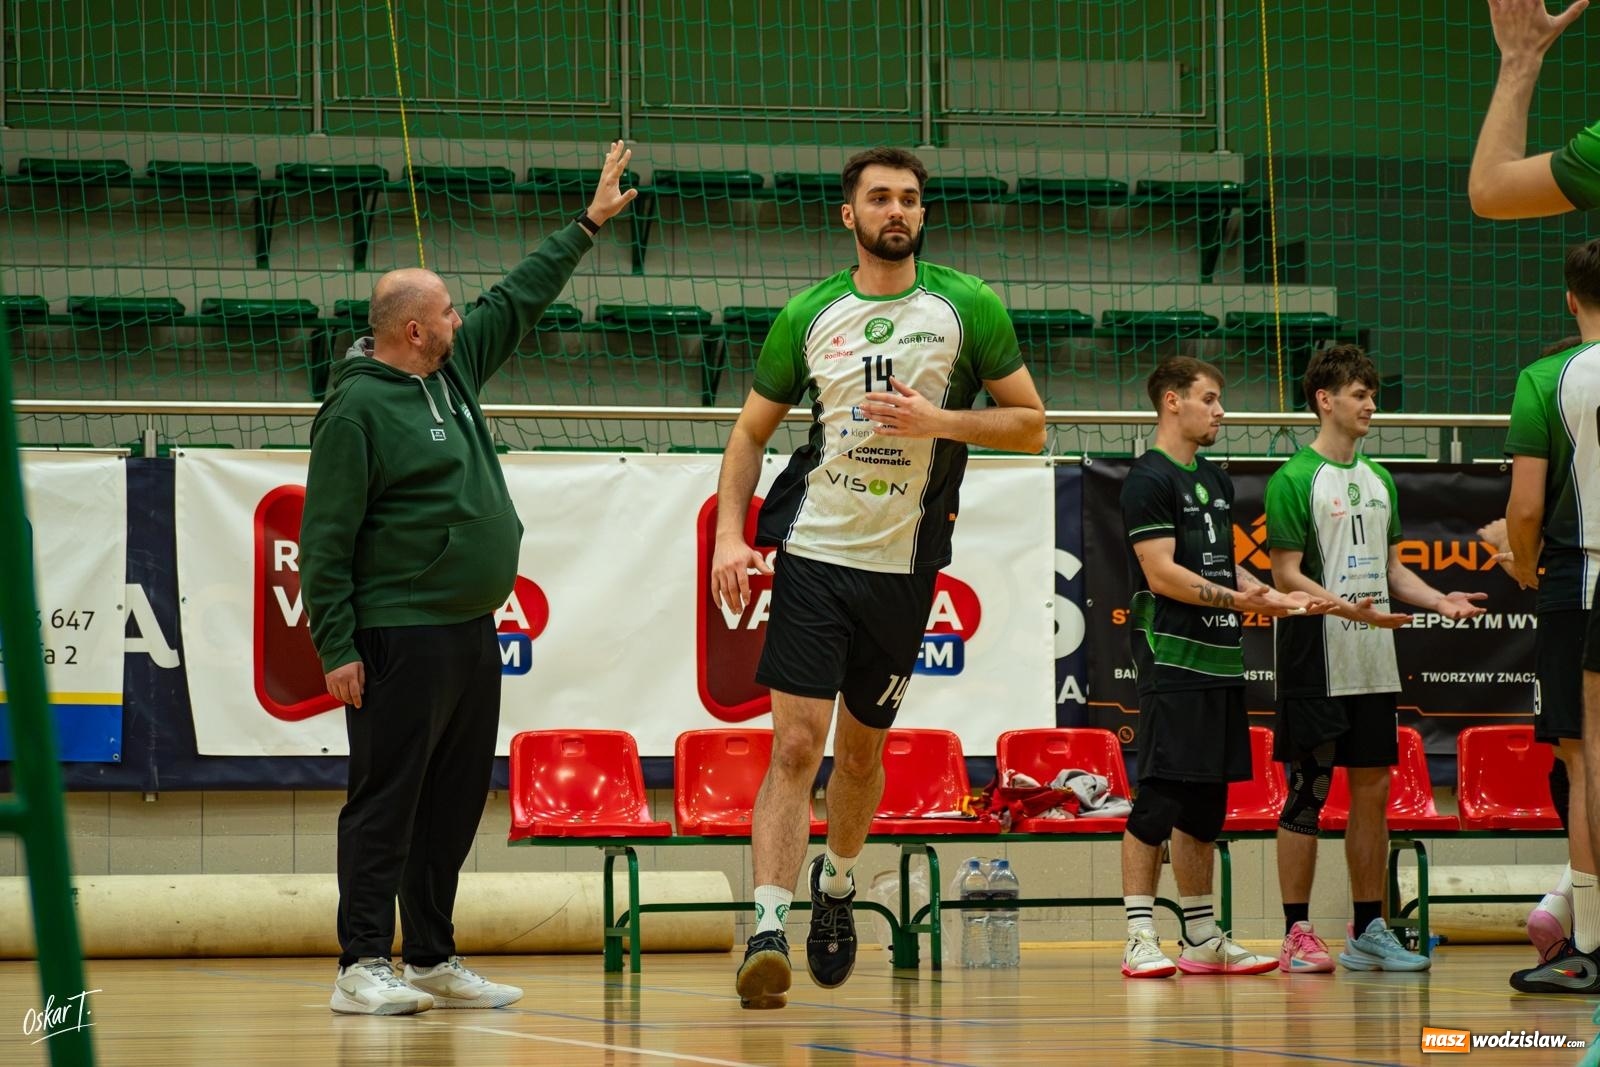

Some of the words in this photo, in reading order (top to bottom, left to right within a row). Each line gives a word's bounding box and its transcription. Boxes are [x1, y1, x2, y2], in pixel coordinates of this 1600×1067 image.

[862, 355, 894, 392] 14
[855, 447, 904, 457] CONCEPT
[855, 456, 912, 467] automatic
[825, 469, 909, 496] VISON
[1204, 512, 1217, 544] 3
[1351, 514, 1366, 545] 11
[51, 608, 95, 631] 647
[65, 645, 78, 665] 2
[1421, 672, 1494, 683] TWORZYMY
[876, 674, 910, 709] 14
